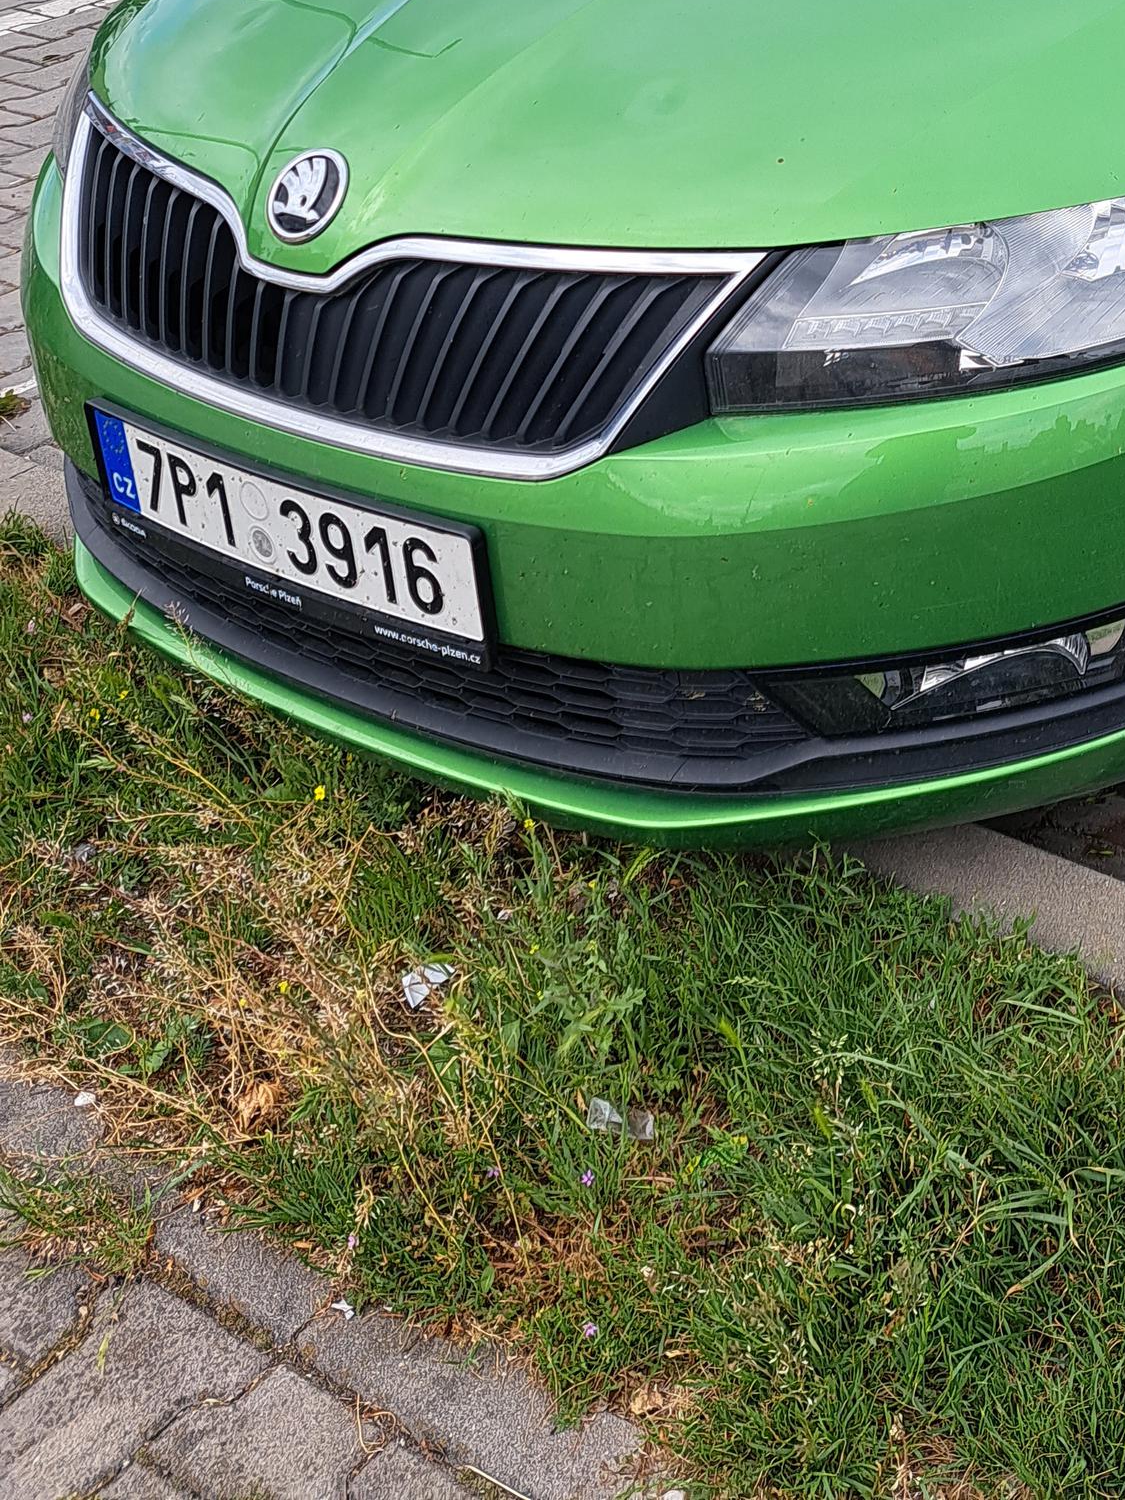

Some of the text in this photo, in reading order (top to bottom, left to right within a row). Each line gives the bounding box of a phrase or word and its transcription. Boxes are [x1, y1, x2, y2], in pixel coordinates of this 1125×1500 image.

[112, 471, 137, 500] CZ
[135, 438, 445, 615] 7P1 3916
